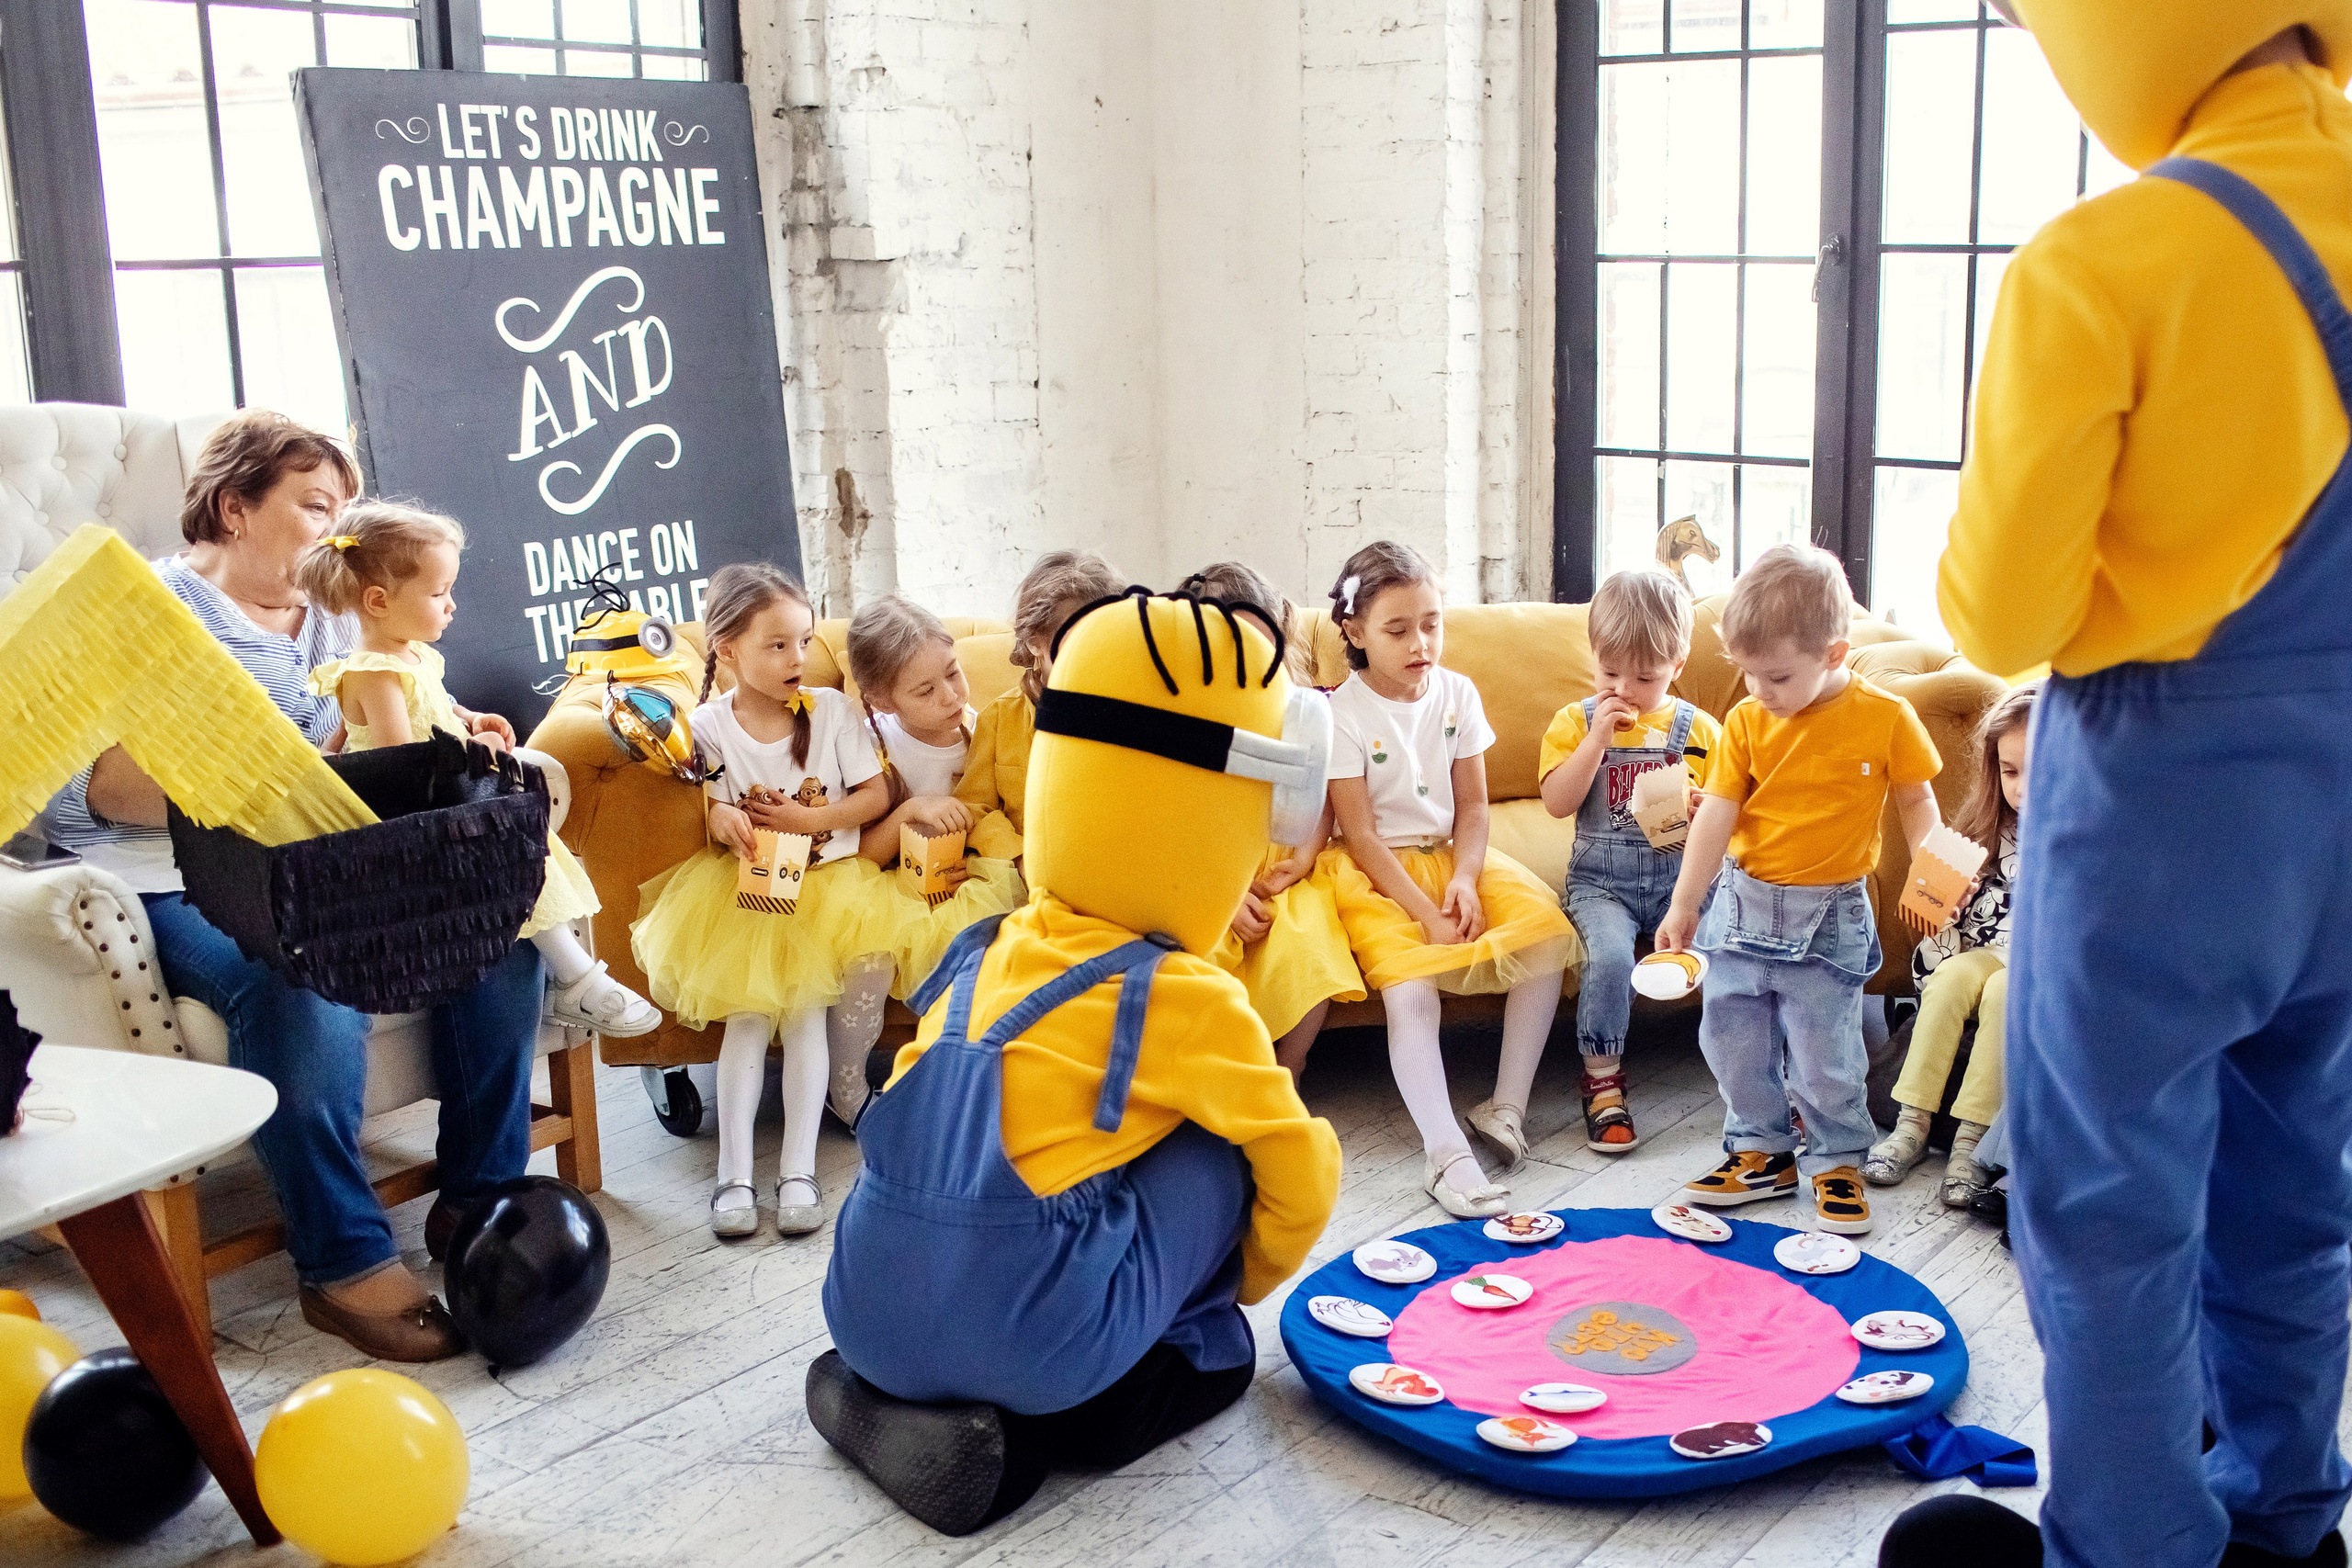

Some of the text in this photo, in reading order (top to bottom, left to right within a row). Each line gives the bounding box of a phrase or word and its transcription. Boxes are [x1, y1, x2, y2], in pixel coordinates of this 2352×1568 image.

[436, 102, 664, 162] LET'S DRINK
[378, 164, 727, 252] CHAMPAGNE
[508, 315, 673, 462] AND
[524, 520, 699, 596] DANCE ON
